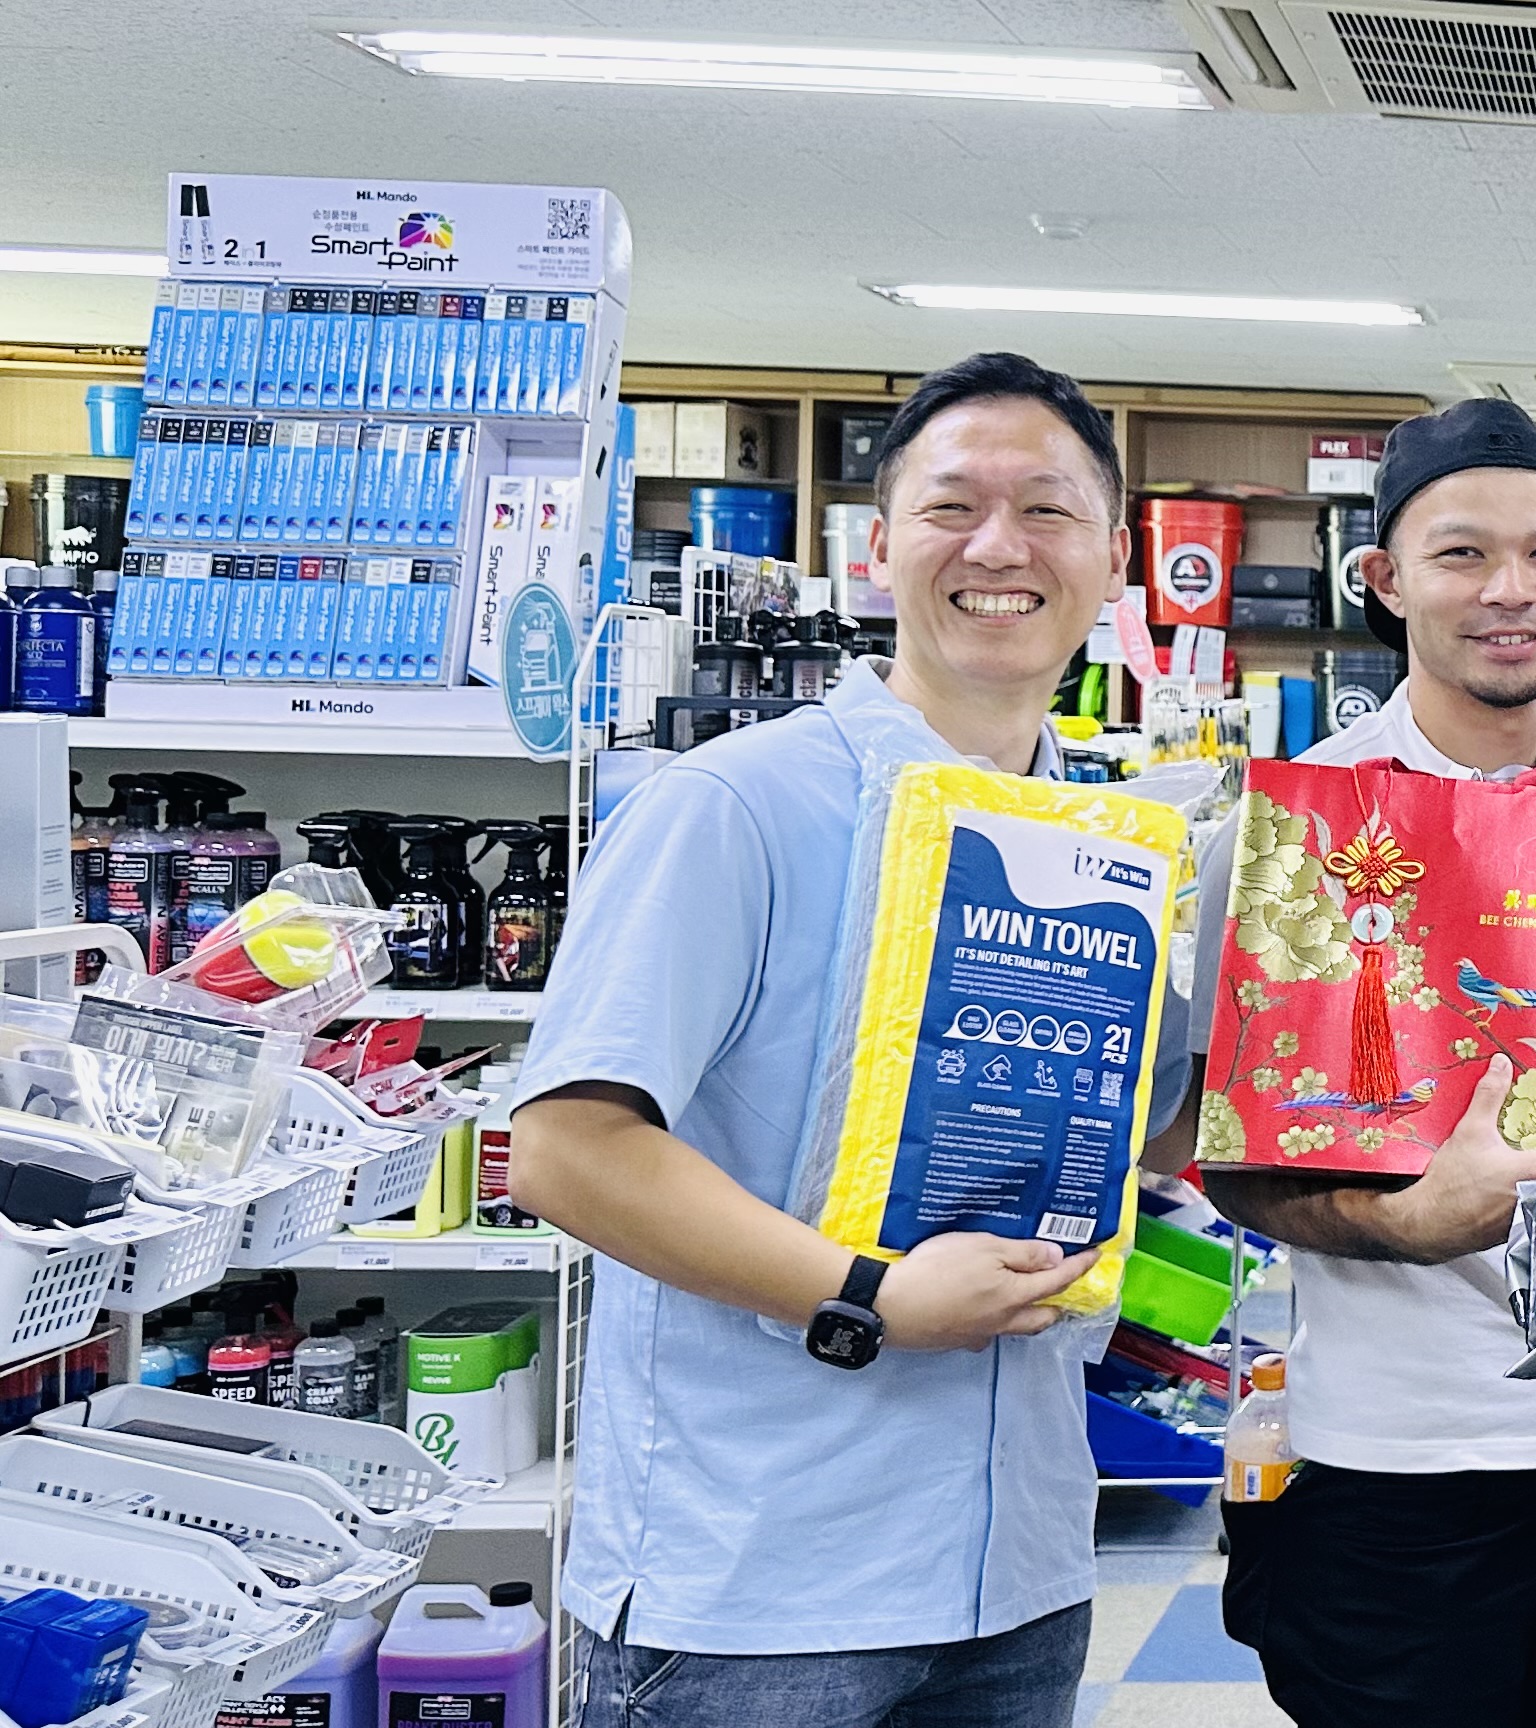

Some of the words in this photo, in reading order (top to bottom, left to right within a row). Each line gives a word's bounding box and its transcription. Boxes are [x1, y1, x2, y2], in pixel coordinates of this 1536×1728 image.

[377, 191, 418, 202] Mando
[224, 239, 239, 258] 2
[255, 240, 267, 259] 1
[311, 235, 394, 255] Smart
[378, 251, 459, 272] Paint
[1320, 441, 1350, 454] FLEX
[319, 700, 374, 714] Mando
[1129, 870, 1150, 886] Win
[1479, 914, 1500, 926] BEE
[963, 904, 1035, 948] WIN
[1039, 917, 1142, 970] TOWEL
[954, 946, 977, 961] IT'S
[977, 951, 1000, 964] NOT
[999, 953, 1051, 972] DETAILING
[1052, 961, 1071, 976] IT'S
[1070, 965, 1089, 979] ART
[1103, 1024, 1132, 1053] 21
[1101, 1051, 1128, 1065] PCS
[211, 1387, 256, 1401] SPEED
